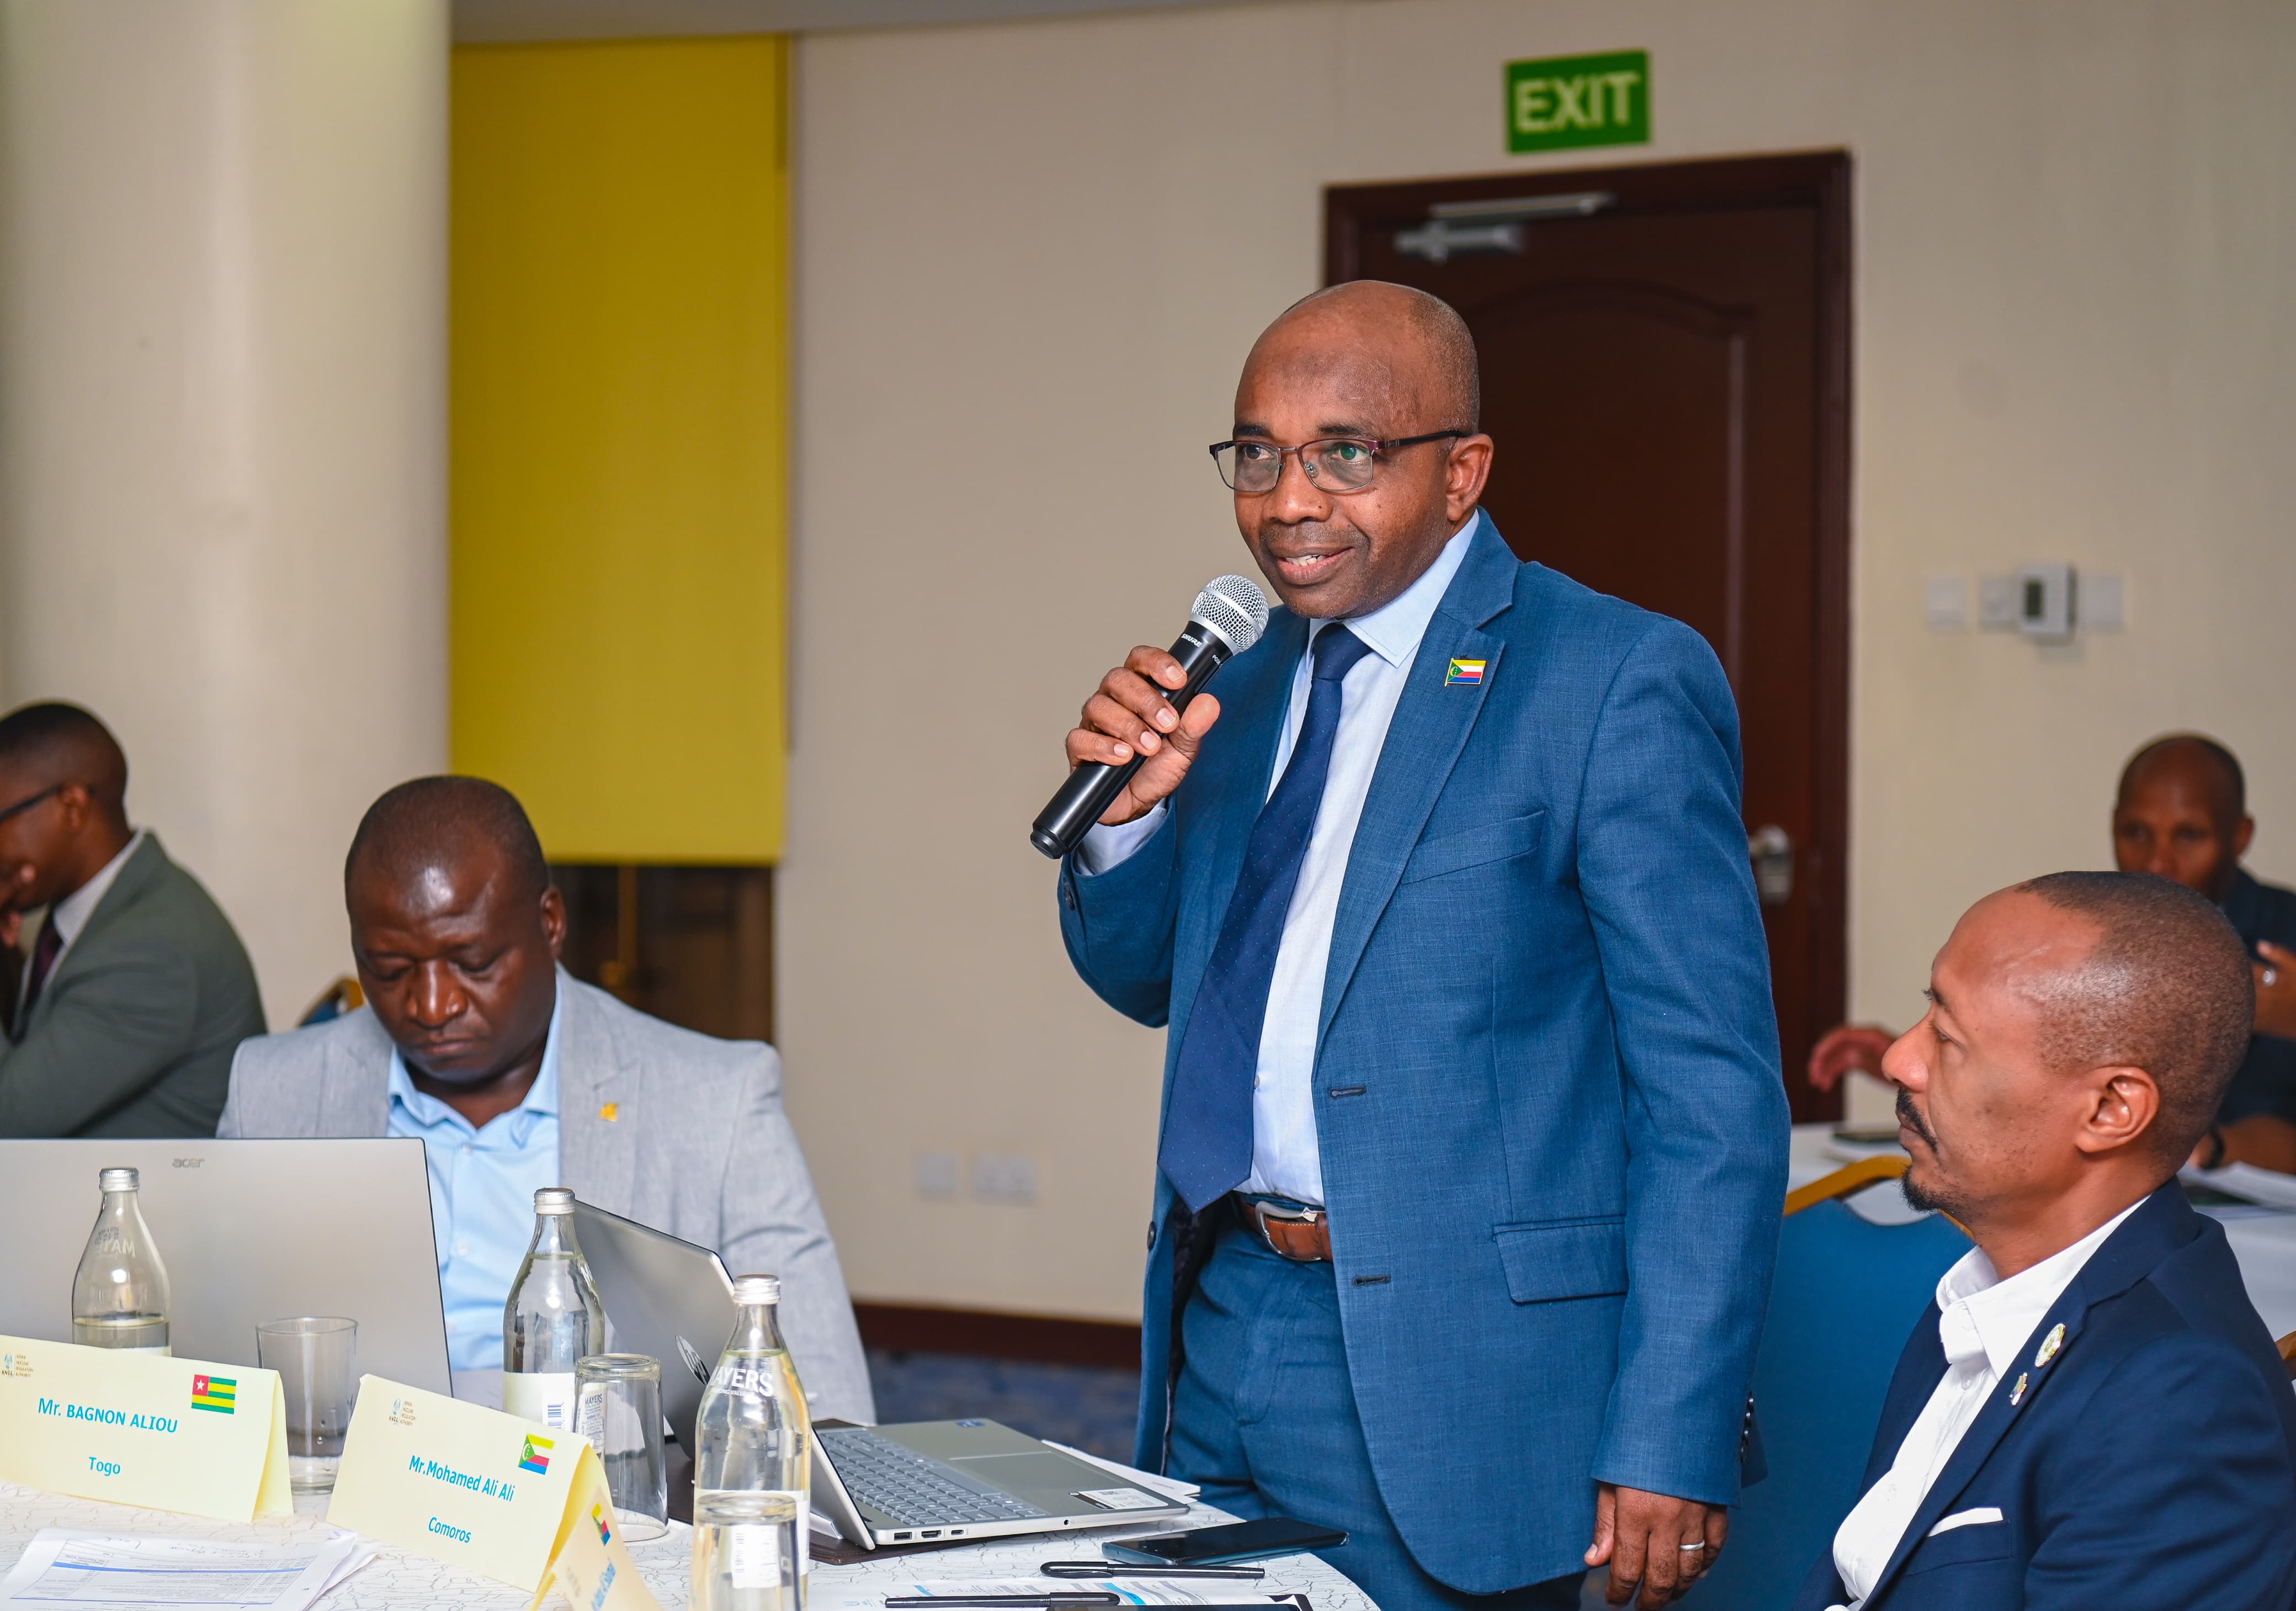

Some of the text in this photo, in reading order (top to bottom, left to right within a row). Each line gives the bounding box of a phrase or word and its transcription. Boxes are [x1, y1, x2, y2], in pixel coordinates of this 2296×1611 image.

[1516, 70, 1640, 133] EXIT
[1181, 633, 1202, 648] SHURE
[172, 1158, 205, 1168] acer
[585, 1393, 603, 1405] MAYERS
[38, 1398, 178, 1433] Mr. BAGNON ALIOU
[89, 1456, 121, 1476] Togo
[409, 1455, 515, 1502] Mr.Mohamed Ali Ali
[428, 1517, 471, 1543] Comoros
